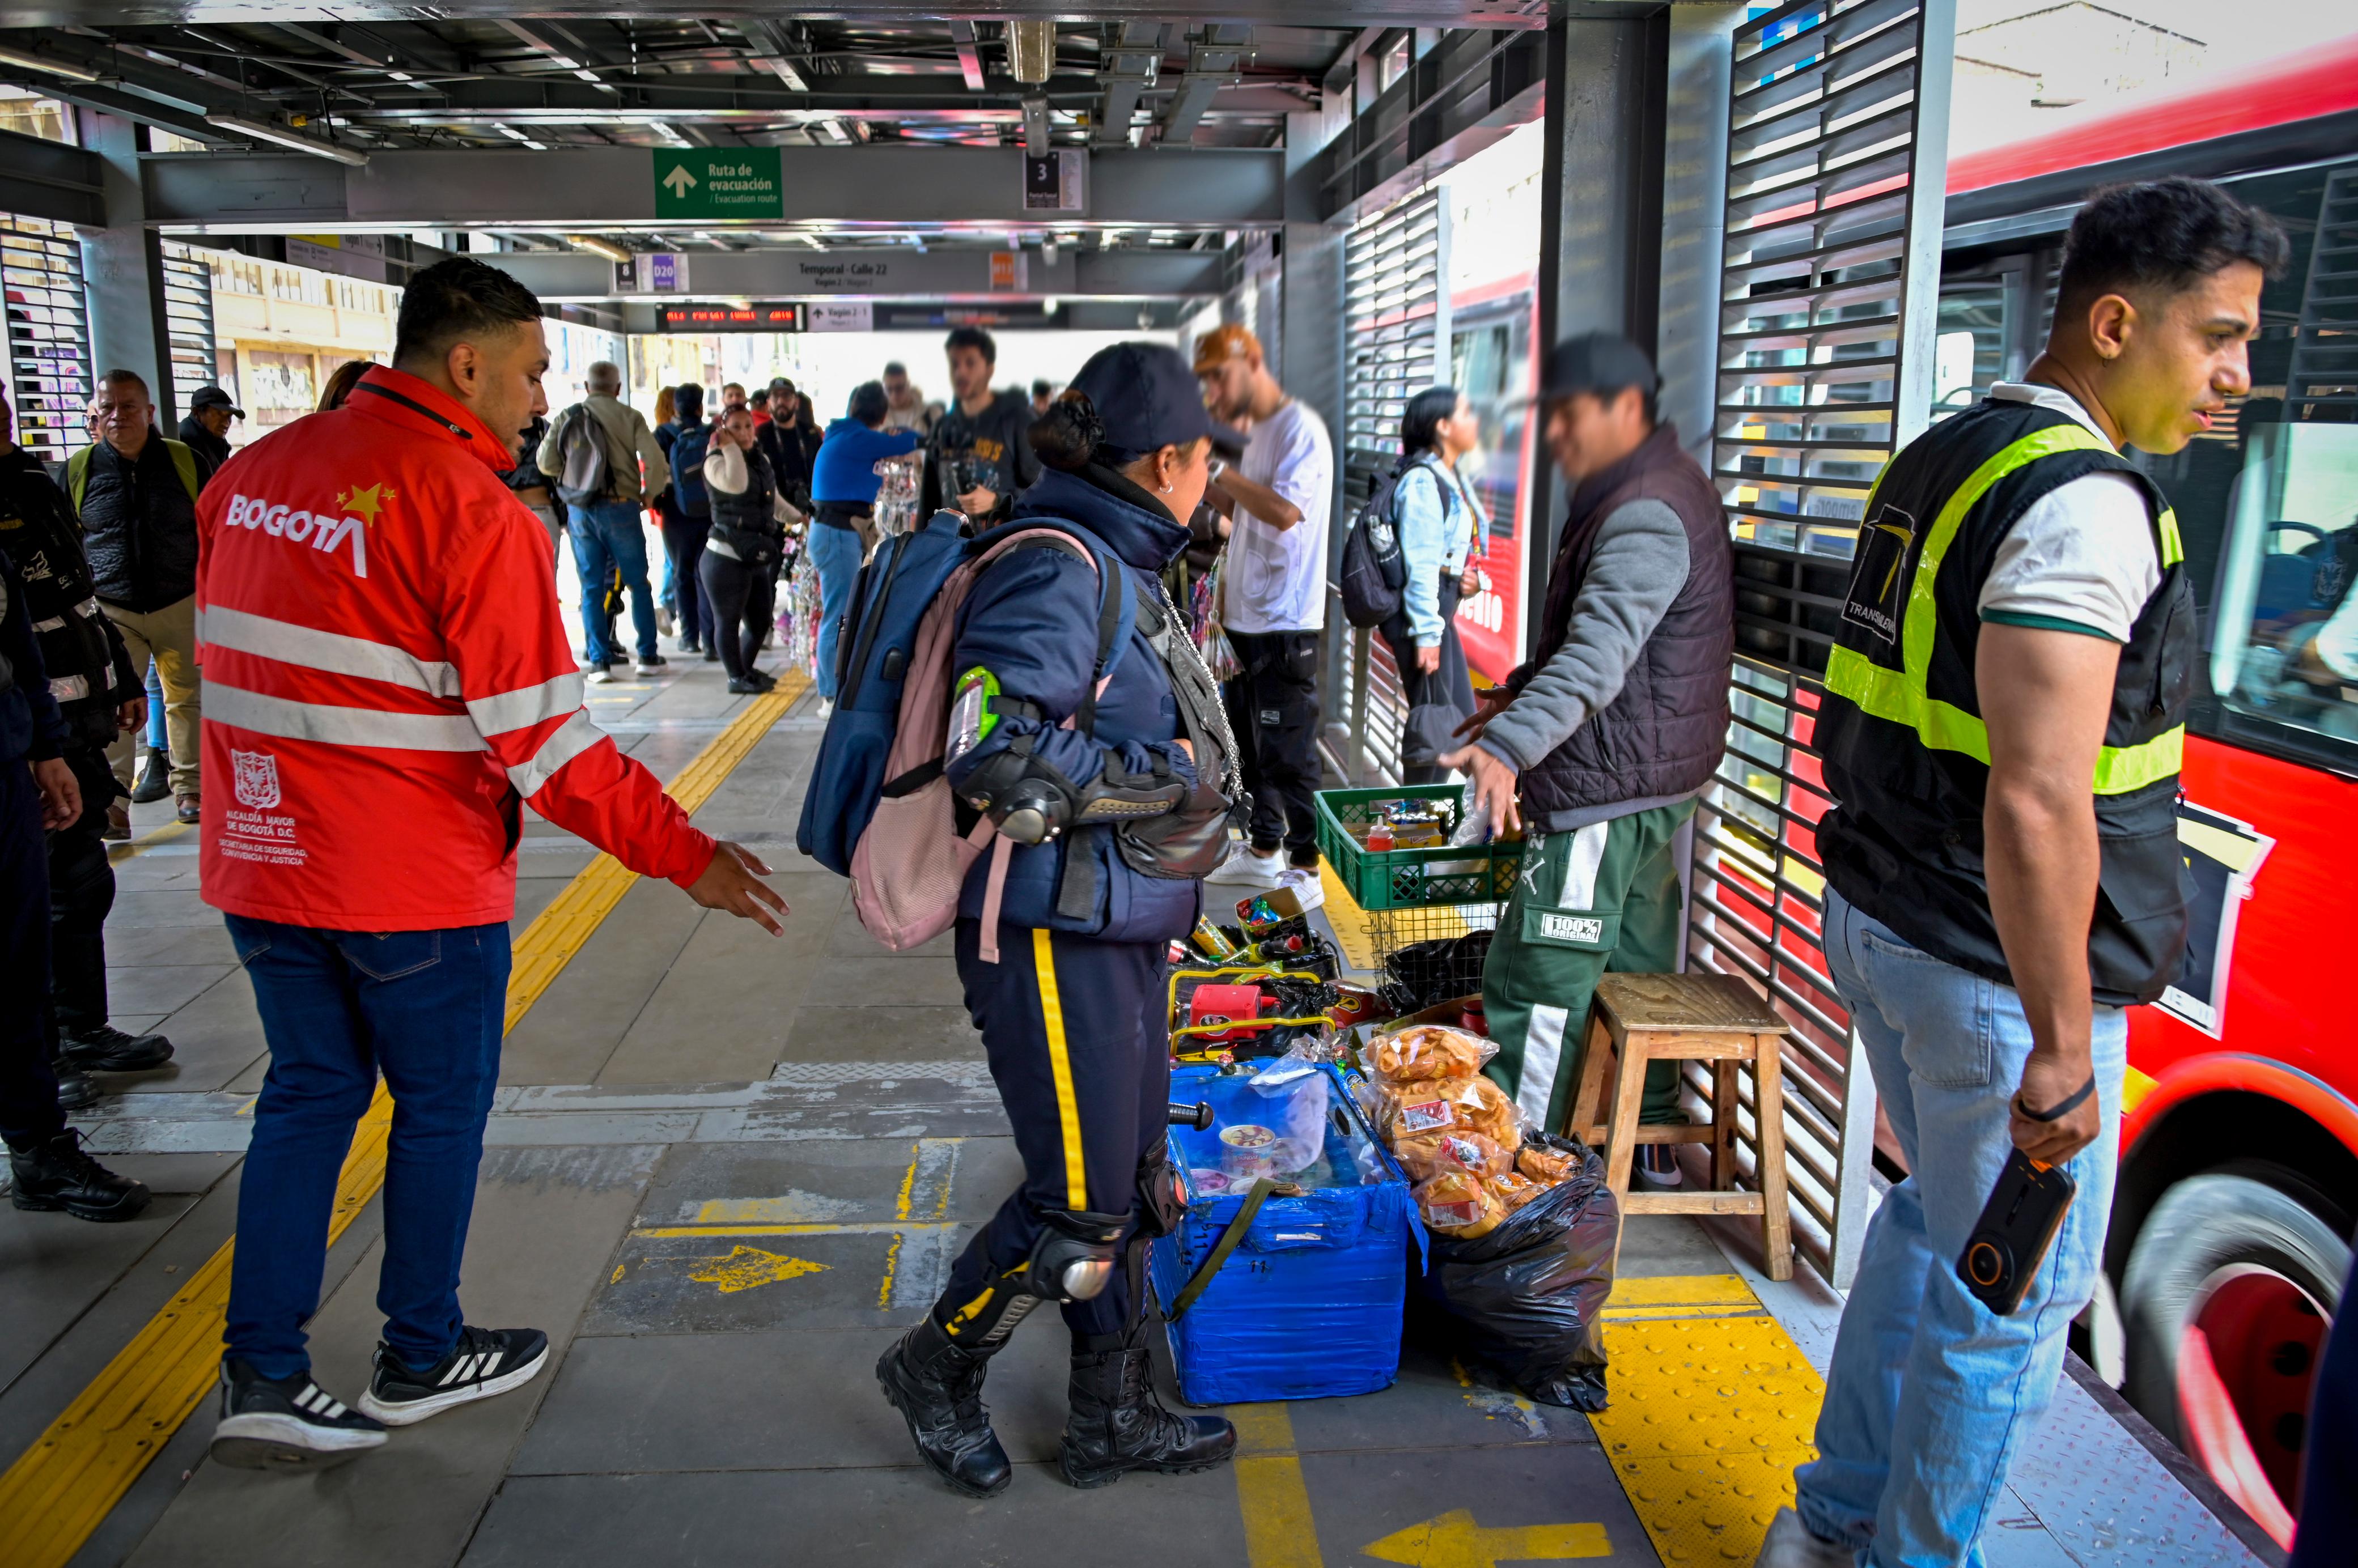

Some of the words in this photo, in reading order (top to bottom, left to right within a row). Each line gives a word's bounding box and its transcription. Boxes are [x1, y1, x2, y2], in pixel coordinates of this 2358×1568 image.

[709, 164, 735, 176] Ruta
[738, 163, 752, 176] de
[1038, 163, 1047, 181] 3
[709, 178, 772, 190] evacuación
[715, 194, 756, 203] Evacuation
[622, 264, 630, 277] 8
[654, 265, 673, 277] D20
[800, 263, 844, 276] Temporal
[851, 264, 874, 274] Calle
[876, 264, 887, 275] 22
[226, 809, 262, 823] ALCALDÍA
[266, 816, 295, 826] MAYOR
[227, 821, 236, 830] DE
[239, 823, 274, 836] BOGOTÁ
[277, 829, 295, 838] D.C.
[222, 848, 263, 861] CONVIVENCIA
[270, 856, 304, 865] JUSTICIA
[1554, 917, 1598, 934] 100%
[1553, 929, 1596, 941] ORIGINAL
